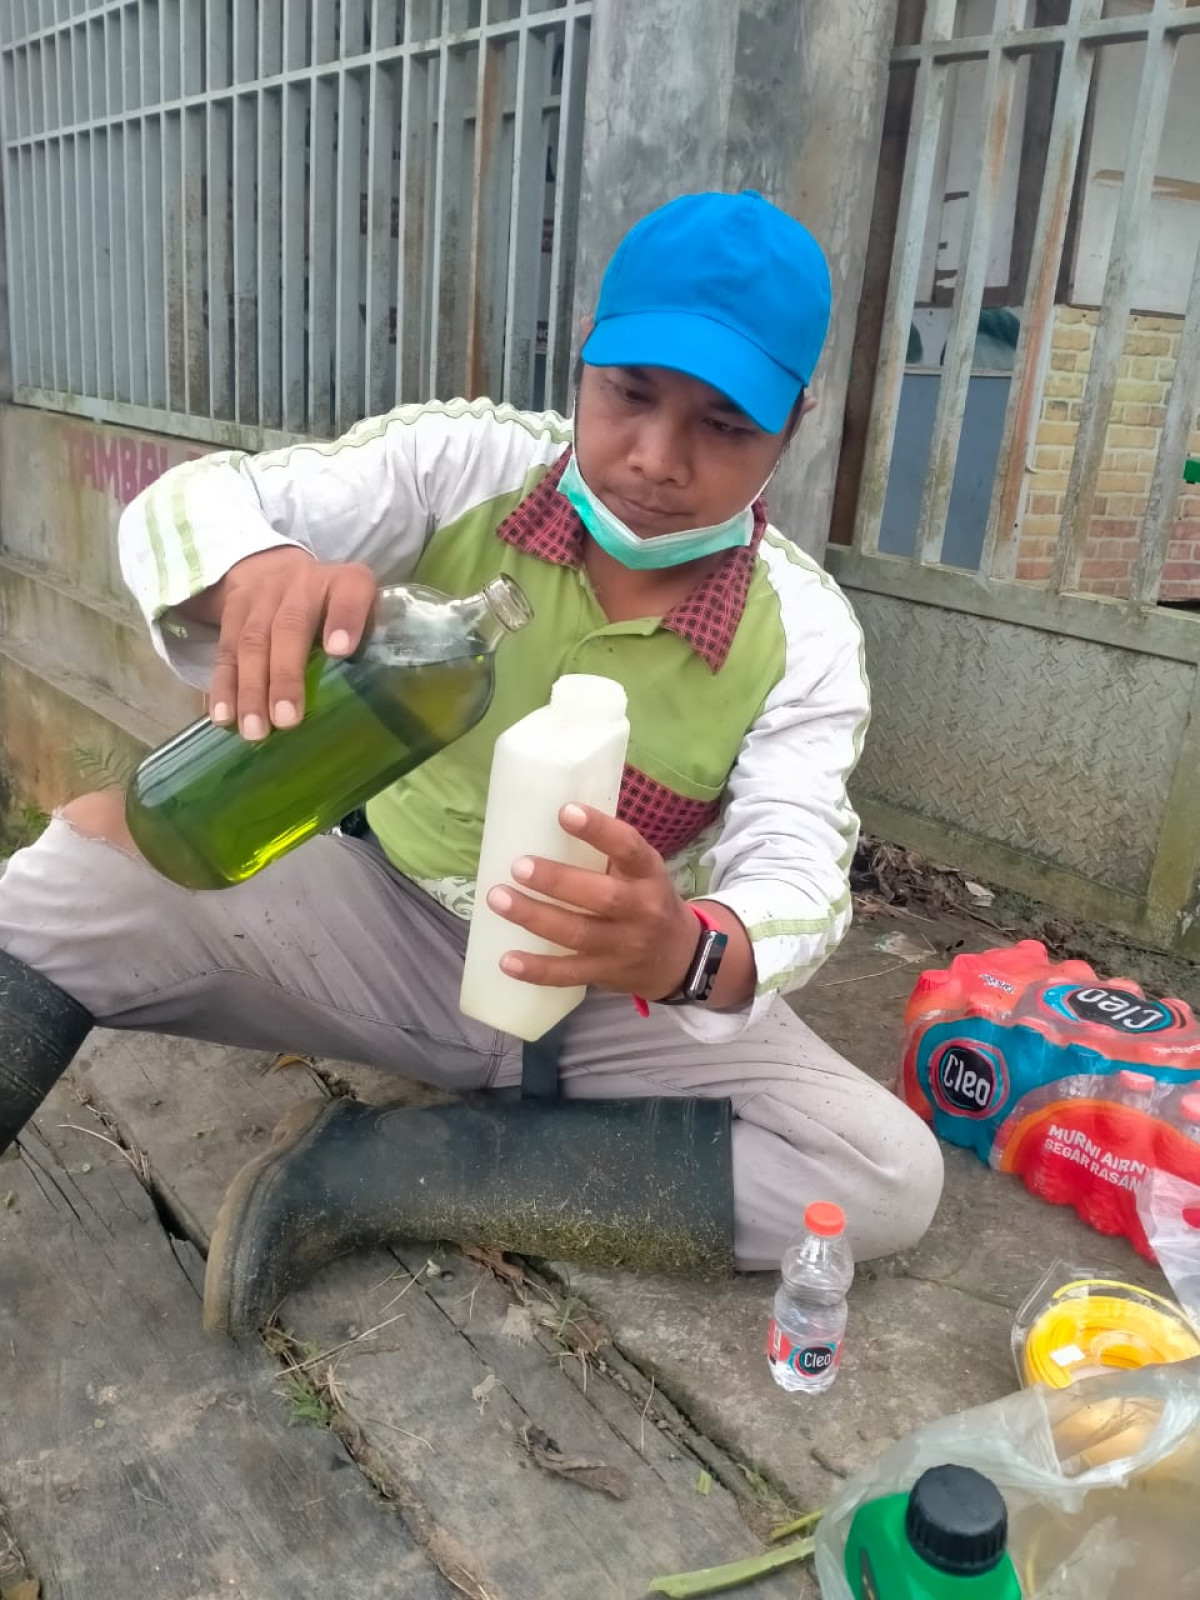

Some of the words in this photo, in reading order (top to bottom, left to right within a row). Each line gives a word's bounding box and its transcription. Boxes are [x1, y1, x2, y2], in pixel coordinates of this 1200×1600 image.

[1076, 988, 1163, 1029] Cleo
[943, 1054, 991, 1106] Cleo
[1044, 1138, 1090, 1169] SEGAR
[1048, 1124, 1101, 1159] MURNI
[1101, 1152, 1149, 1176] AIRN
[804, 1352, 831, 1368] Cleo
